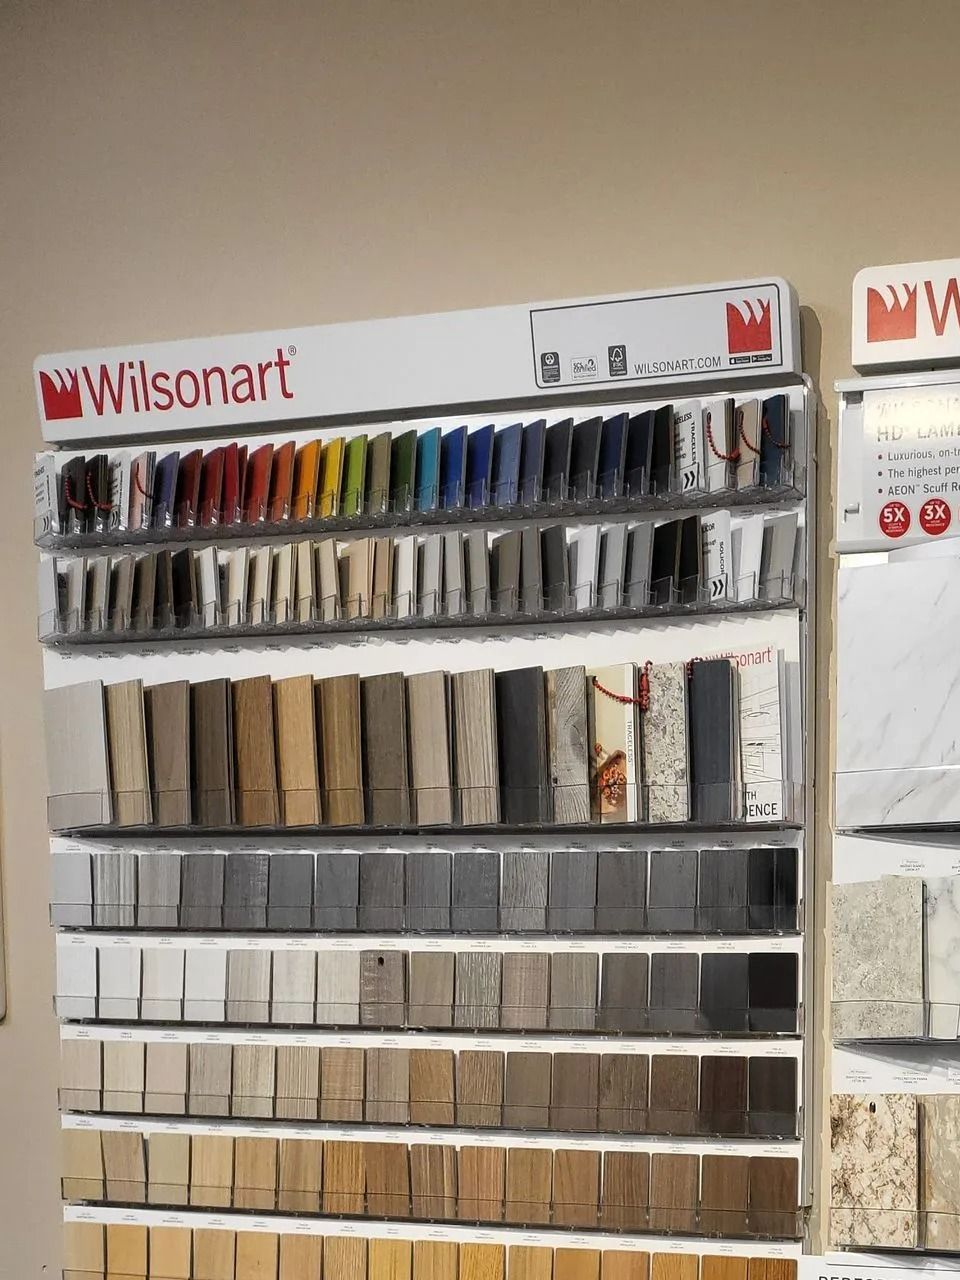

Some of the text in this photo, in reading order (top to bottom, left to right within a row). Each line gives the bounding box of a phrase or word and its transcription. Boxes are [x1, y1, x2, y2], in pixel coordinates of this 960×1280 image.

[634, 356, 721, 375] WILSONART.COM
[888, 448, 935, 462] Luxurious,
[888, 468, 905, 480] The
[908, 465, 942, 480] highest
[923, 481, 948, 494] Scuff
[883, 507, 905, 523] 5X
[924, 504, 946, 520] 3X
